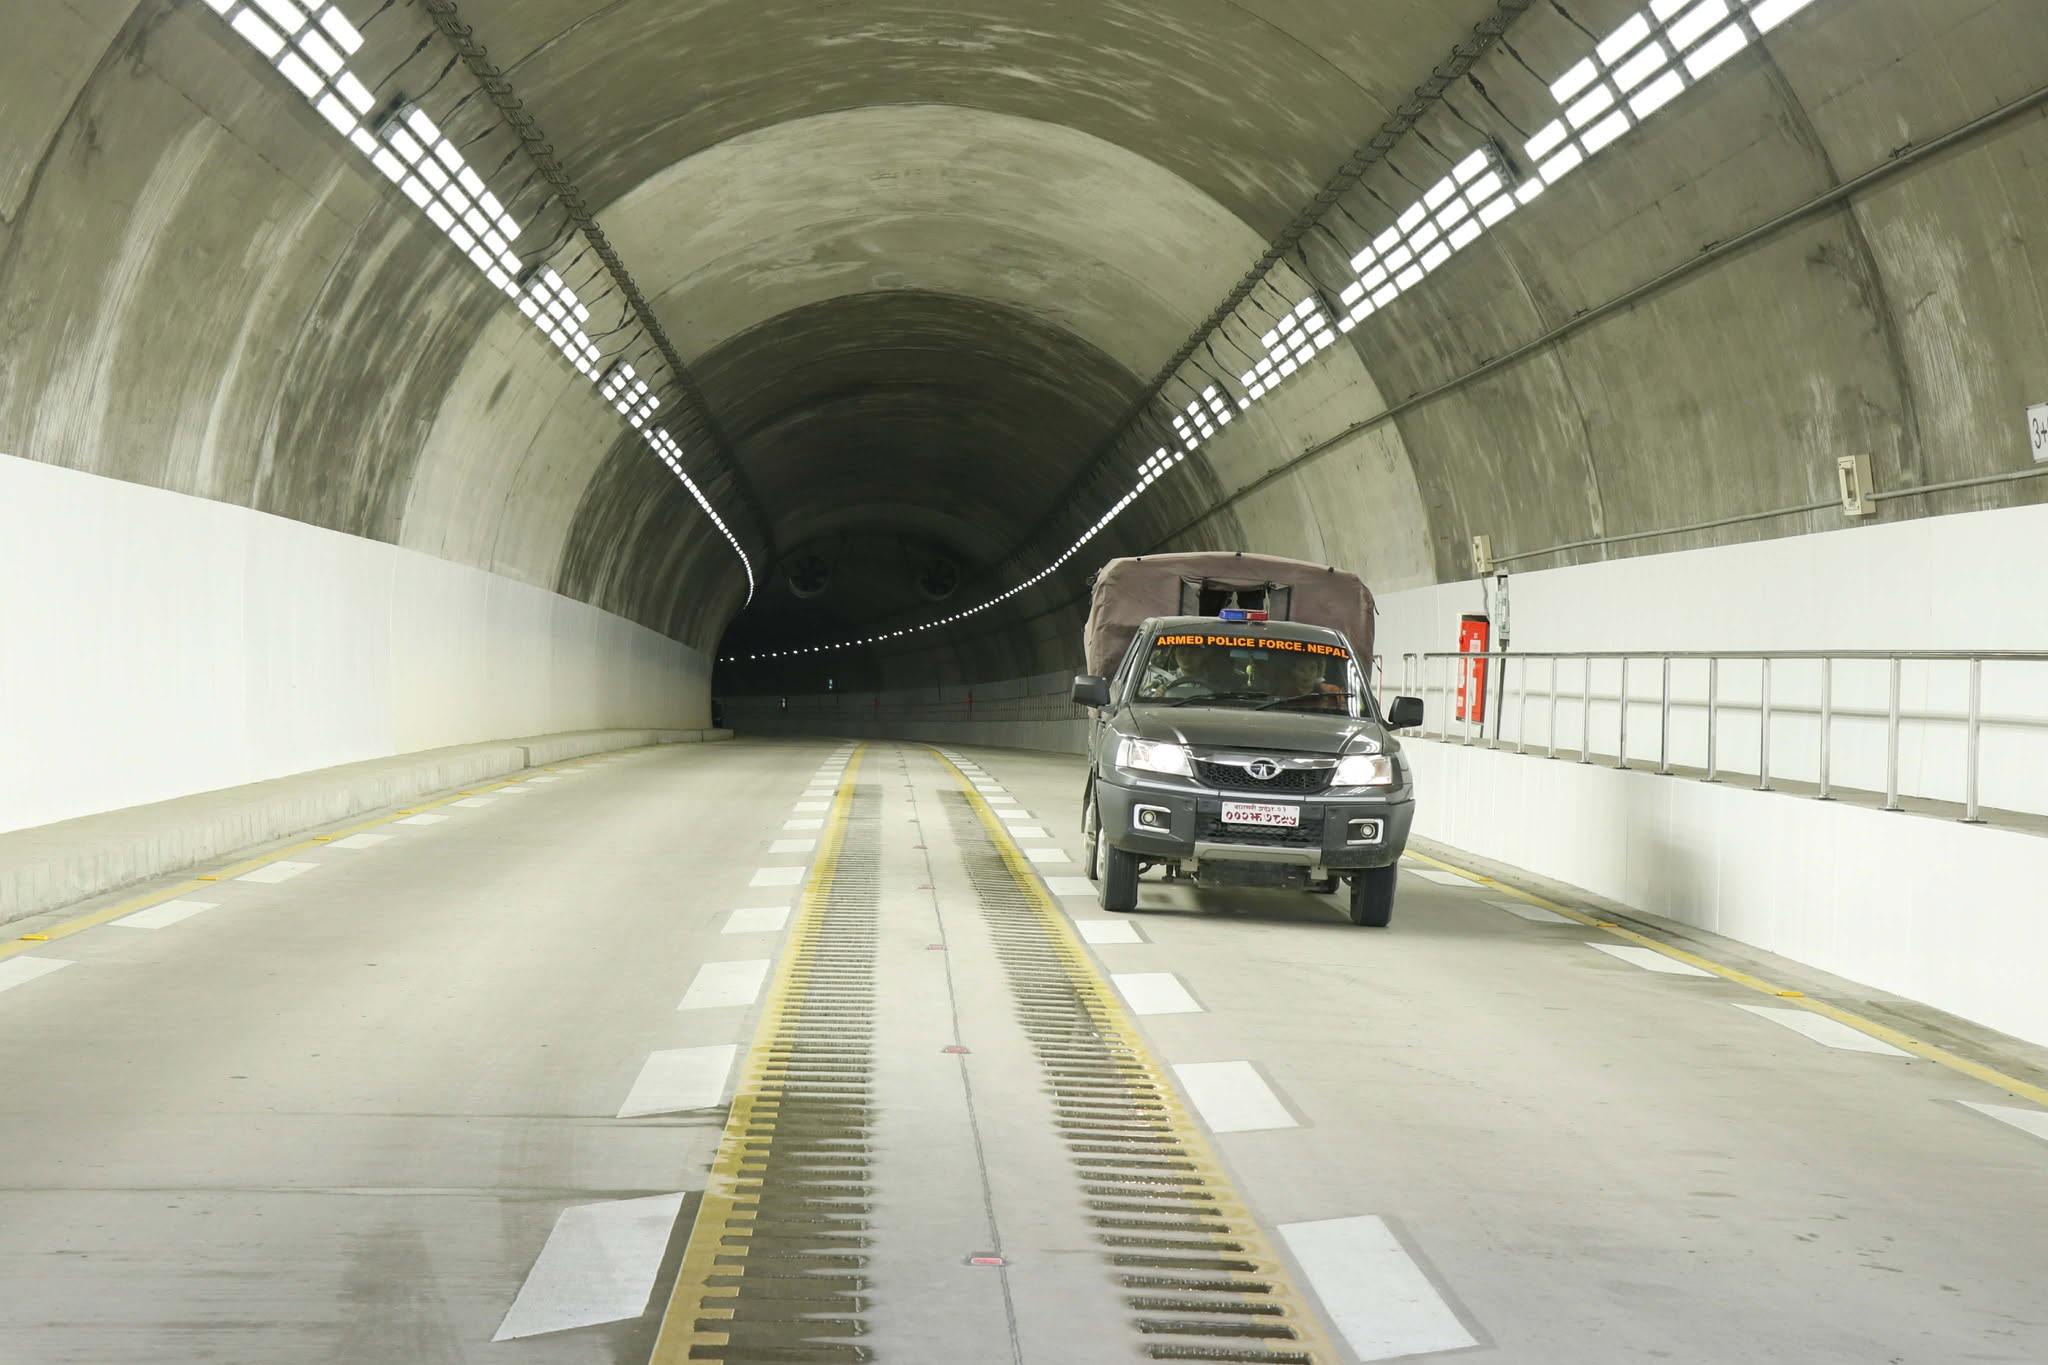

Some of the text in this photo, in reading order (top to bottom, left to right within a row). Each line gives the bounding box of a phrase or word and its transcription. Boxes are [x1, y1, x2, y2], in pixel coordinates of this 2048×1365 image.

[2032, 417, 2048, 449] 3+
[1157, 635, 1203, 646] ARMED
[1207, 636, 1255, 647] POLICE
[1307, 644, 1350, 659] NEPAL
